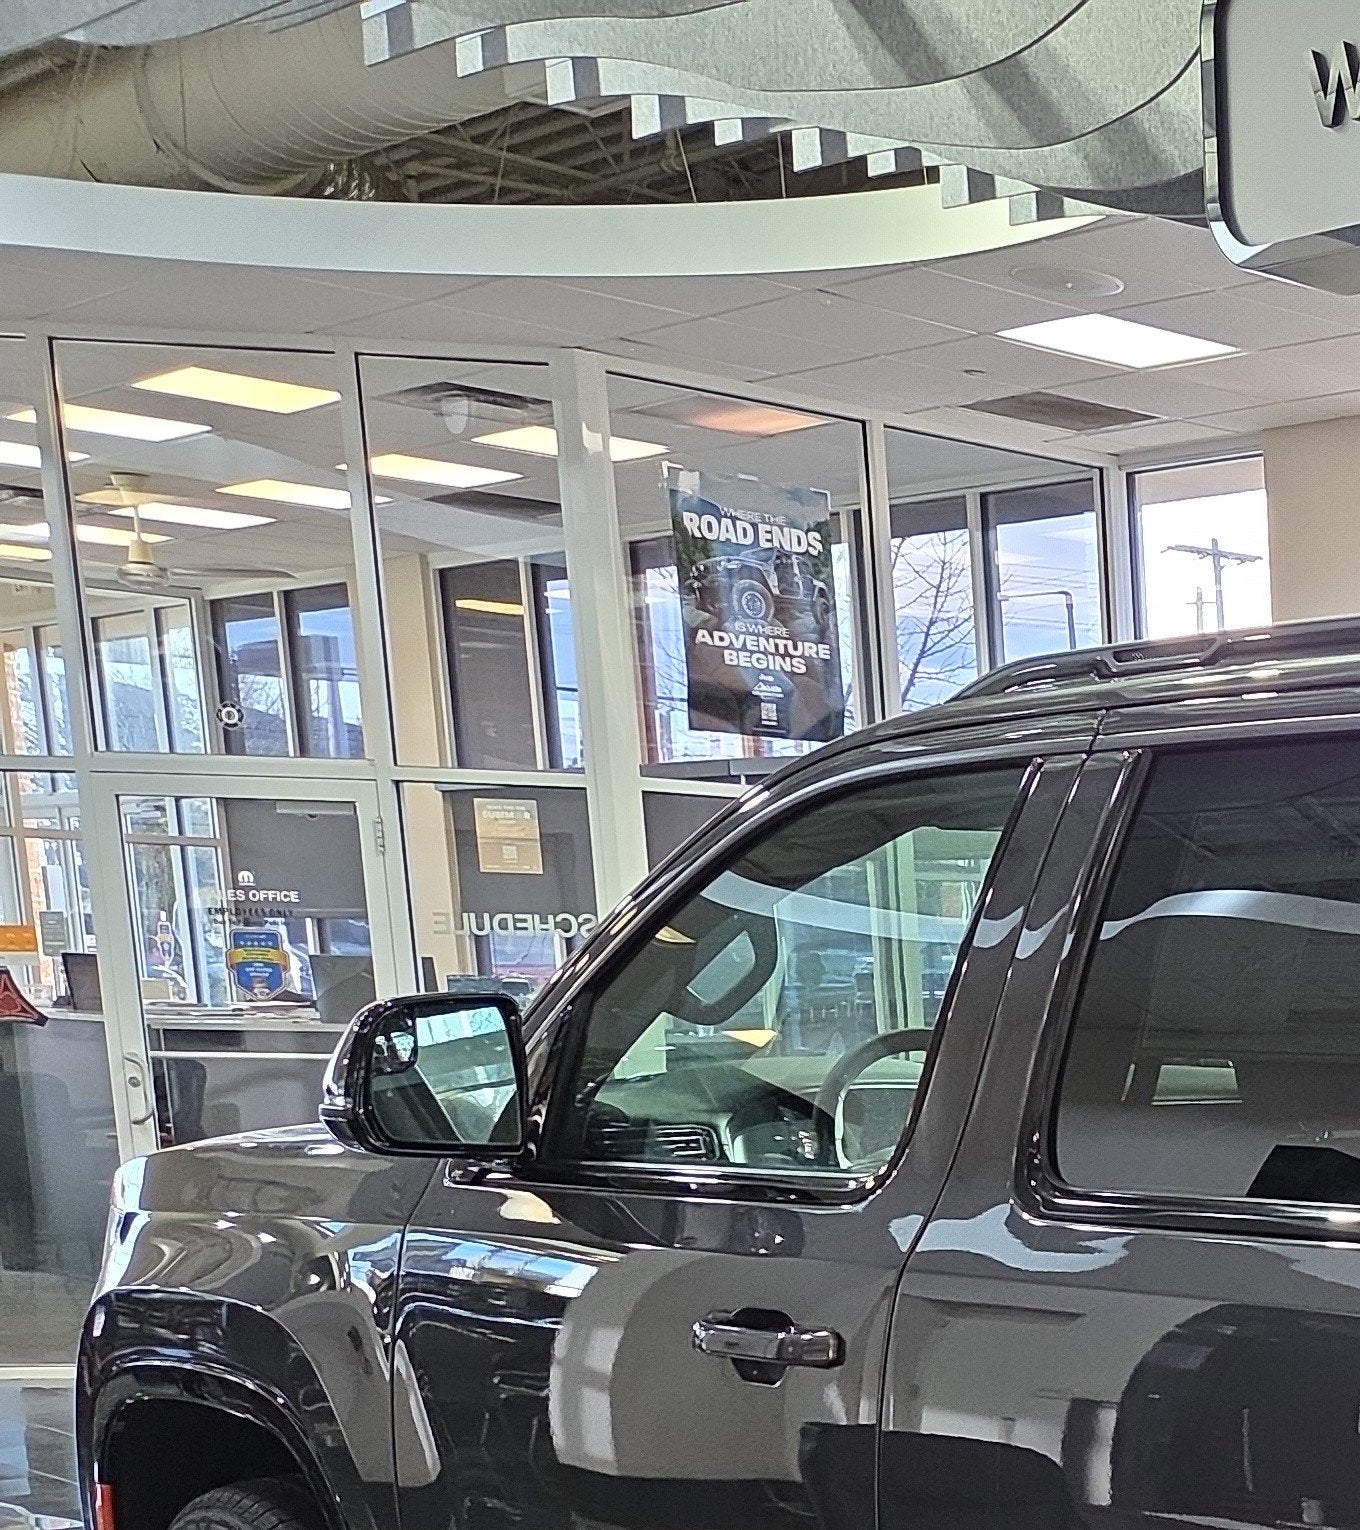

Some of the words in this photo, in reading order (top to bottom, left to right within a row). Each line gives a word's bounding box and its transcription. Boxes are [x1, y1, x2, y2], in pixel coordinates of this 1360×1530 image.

[718, 505, 763, 522] WHERE
[764, 513, 787, 526] THE
[682, 511, 755, 546] ROAD
[757, 523, 824, 556] ENDS
[735, 620, 747, 633] IS
[747, 624, 791, 638] WHERE
[694, 629, 832, 660] ADVENTURE
[723, 649, 807, 674] BEGINS
[248, 889, 301, 903] OFFICE
